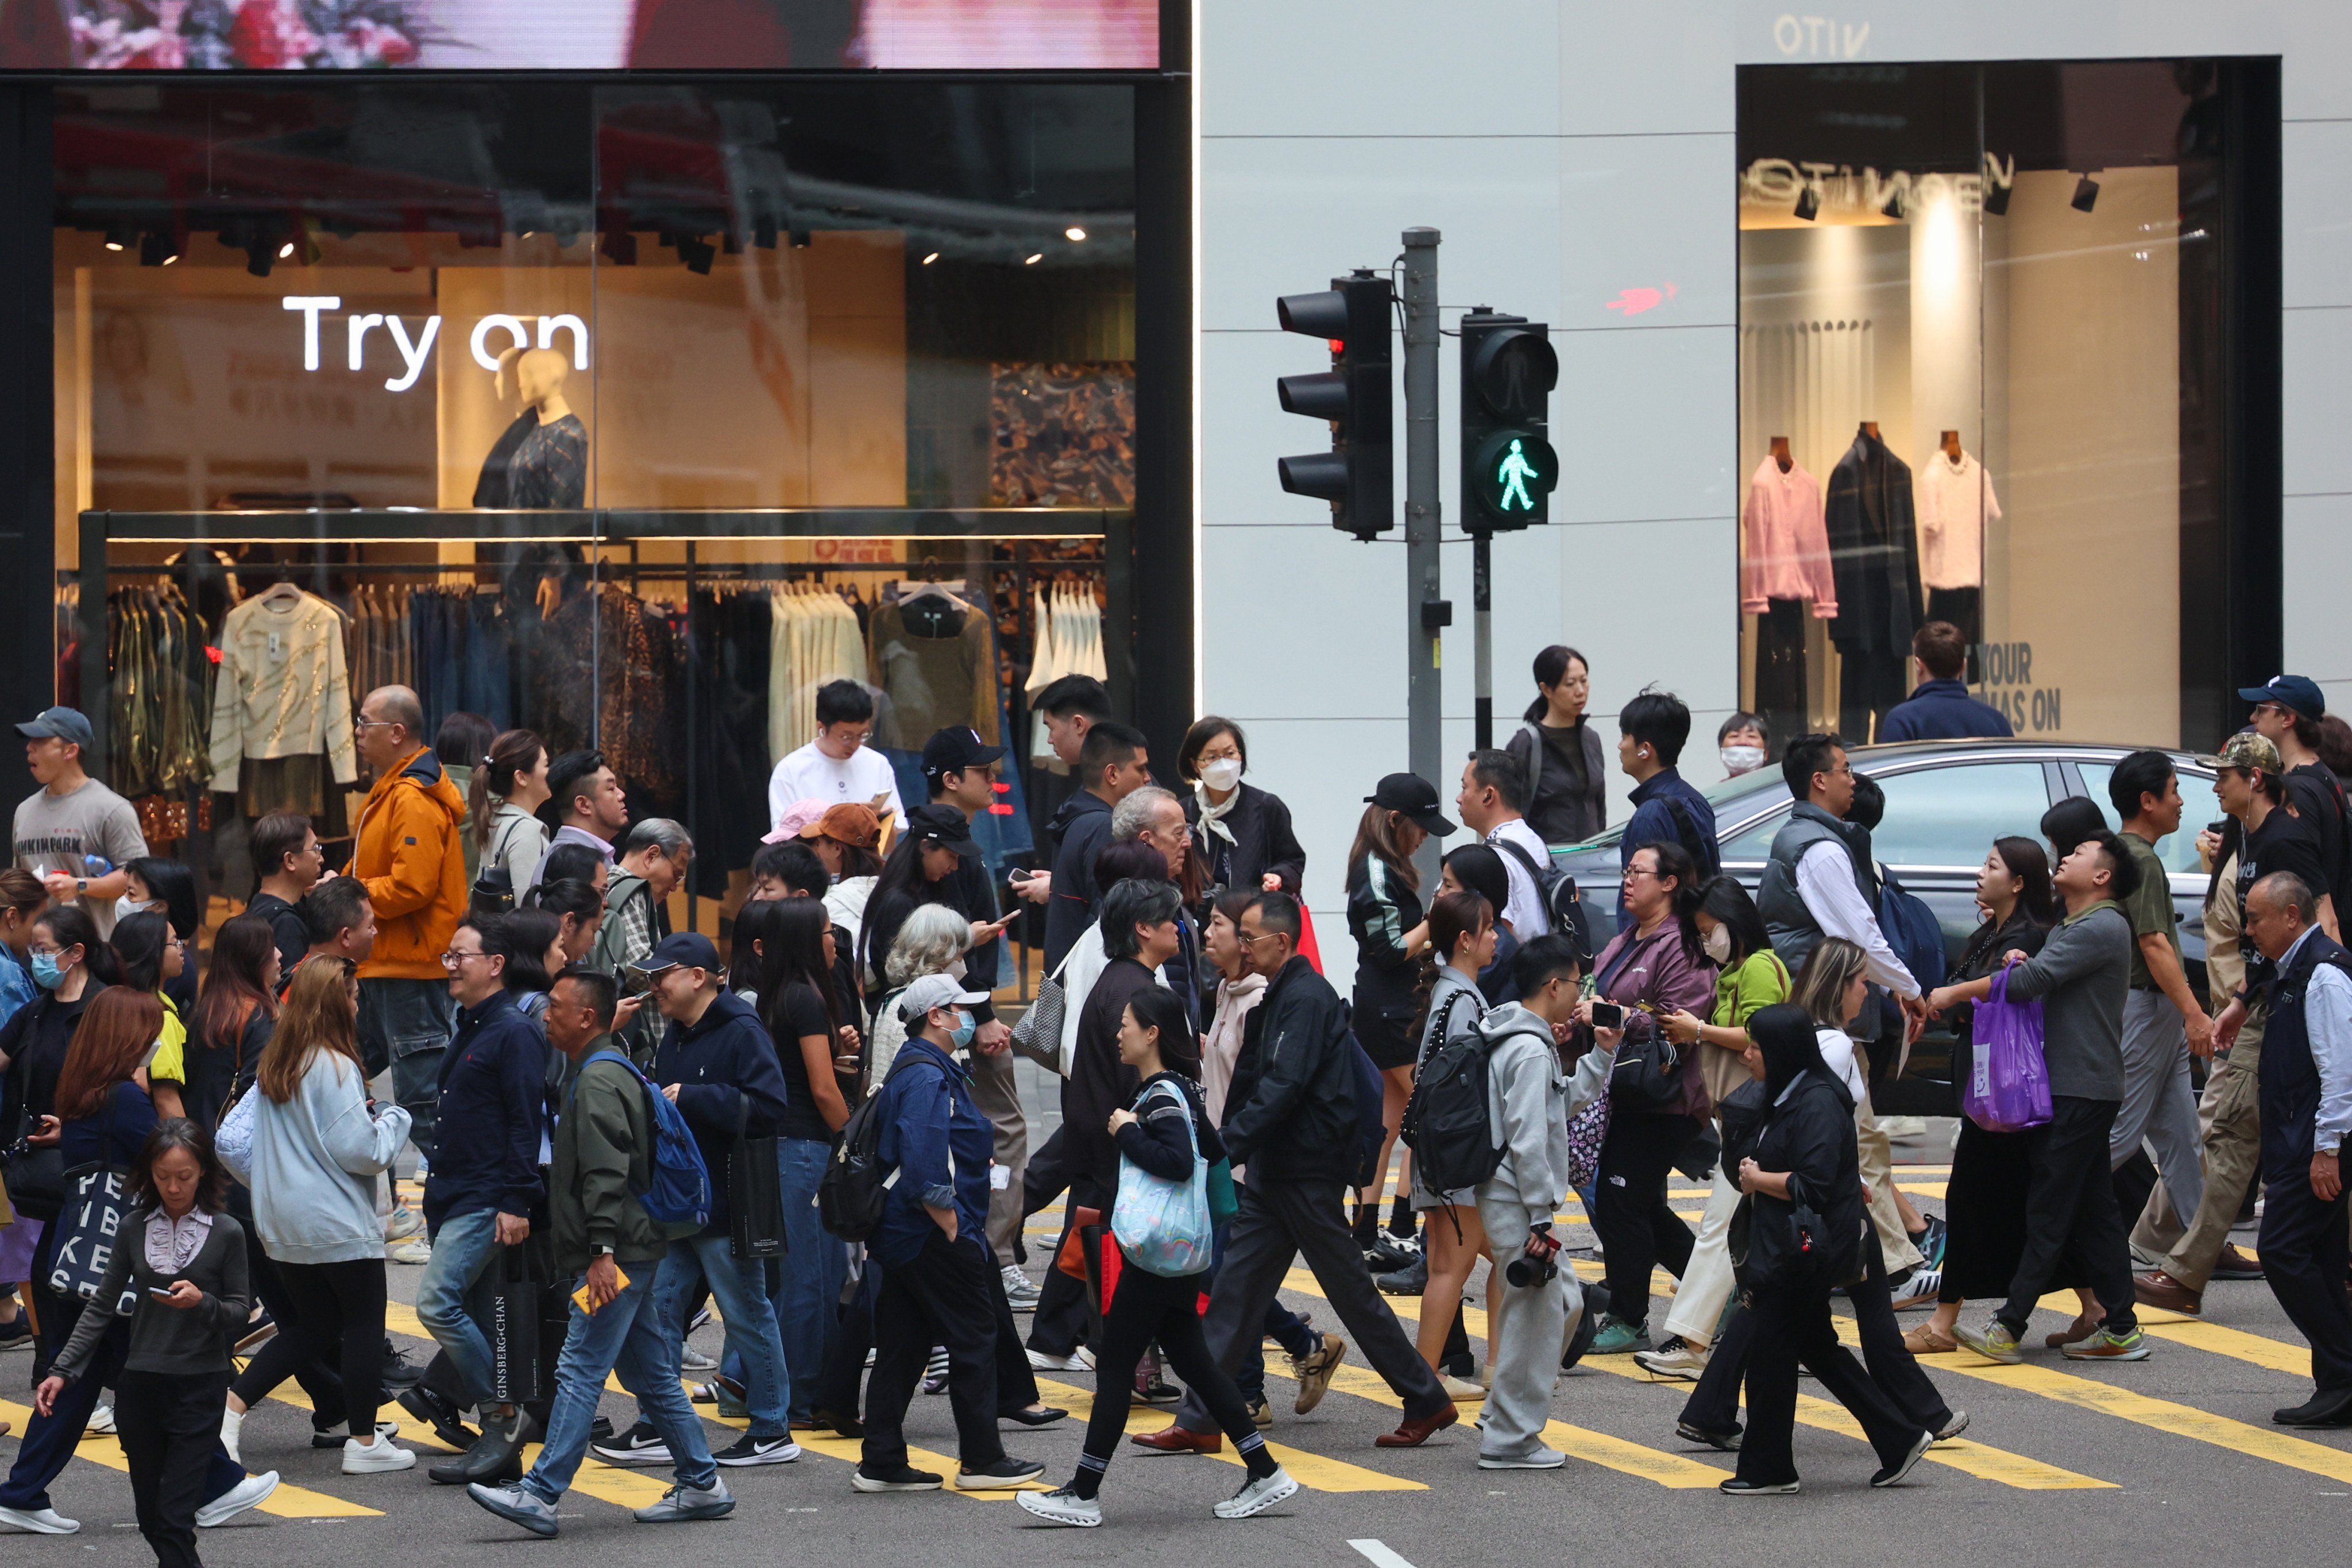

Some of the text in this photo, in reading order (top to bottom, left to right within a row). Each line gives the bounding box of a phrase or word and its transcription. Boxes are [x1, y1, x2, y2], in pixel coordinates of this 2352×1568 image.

[283, 296, 588, 391] Try on
[1975, 642, 2031, 685] YOUR
[2032, 688, 2061, 731] ON
[496, 1296, 507, 1398] GINSBERG+CHAN
